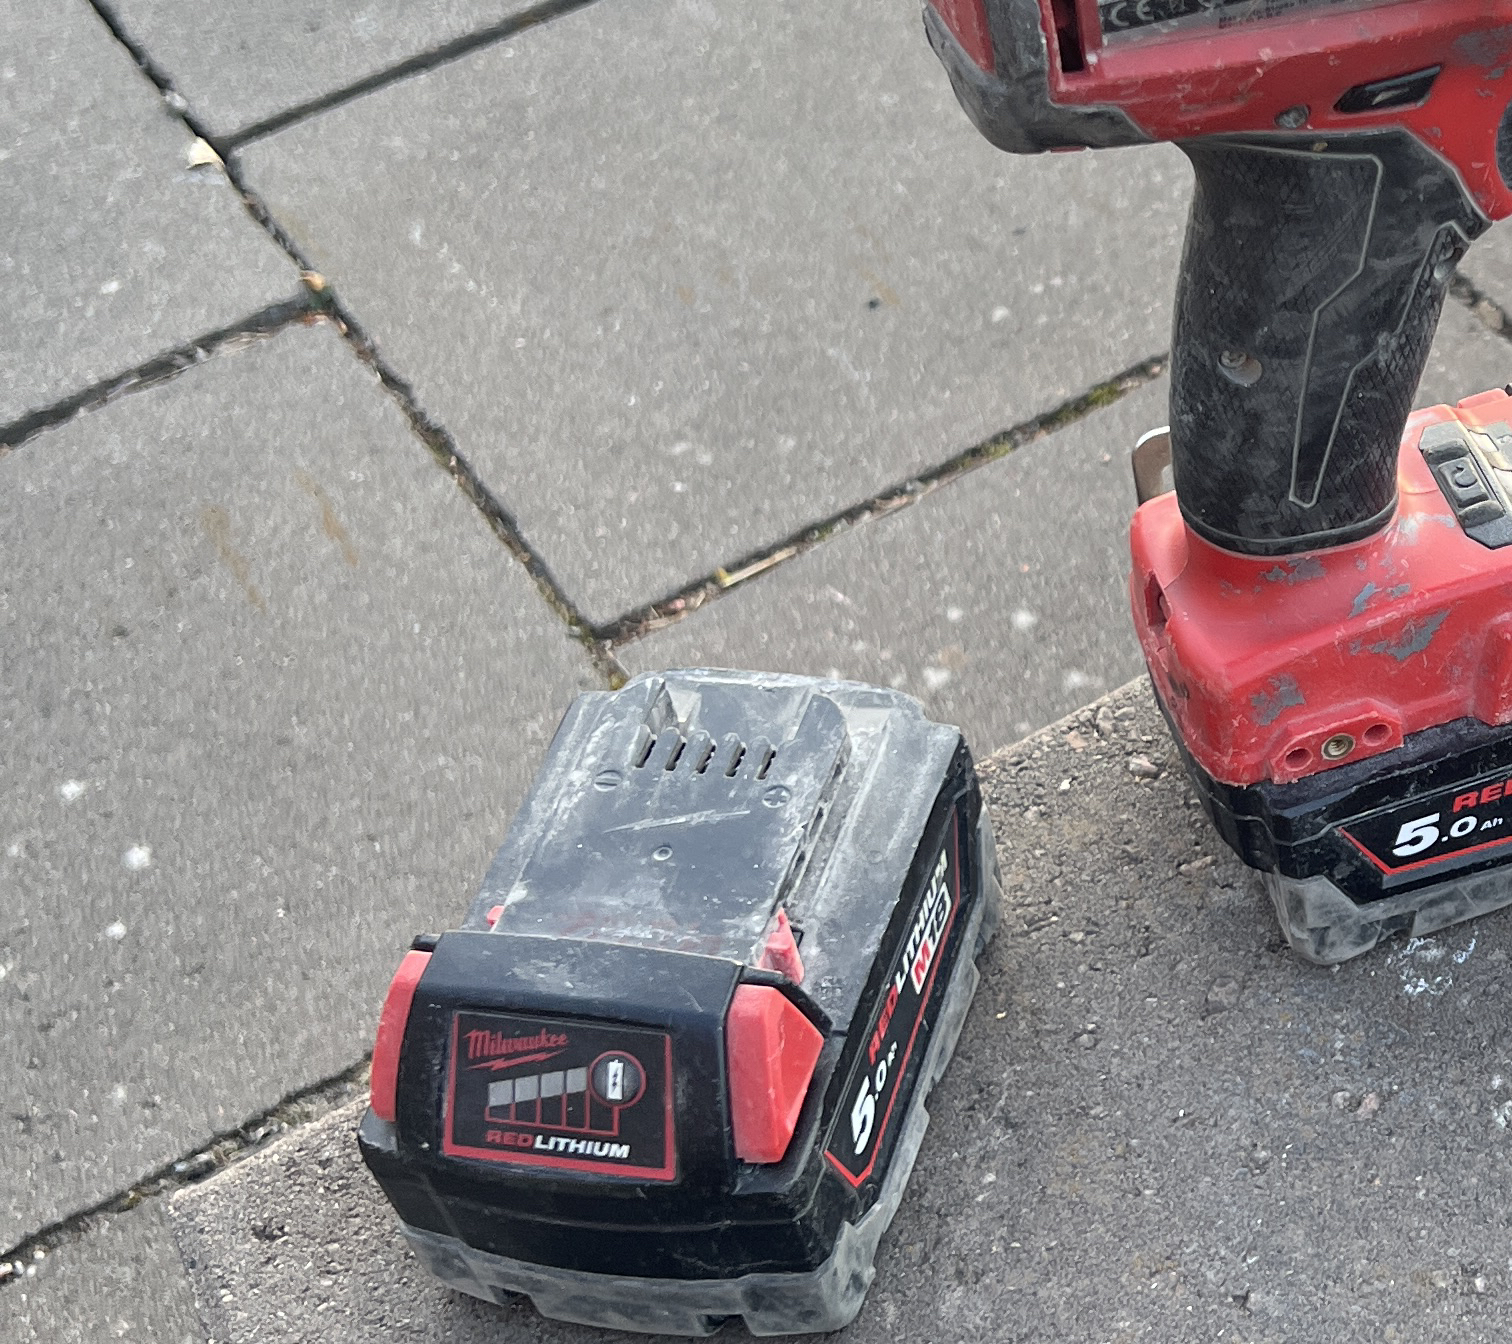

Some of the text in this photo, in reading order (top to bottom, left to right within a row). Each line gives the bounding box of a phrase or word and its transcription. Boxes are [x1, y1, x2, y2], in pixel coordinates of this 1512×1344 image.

[1392, 812, 1478, 857] 5.0
[914, 890, 948, 987] M18
[463, 1027, 570, 1060] Milwaukee
[485, 1129, 631, 1160] REDLITHIUM
